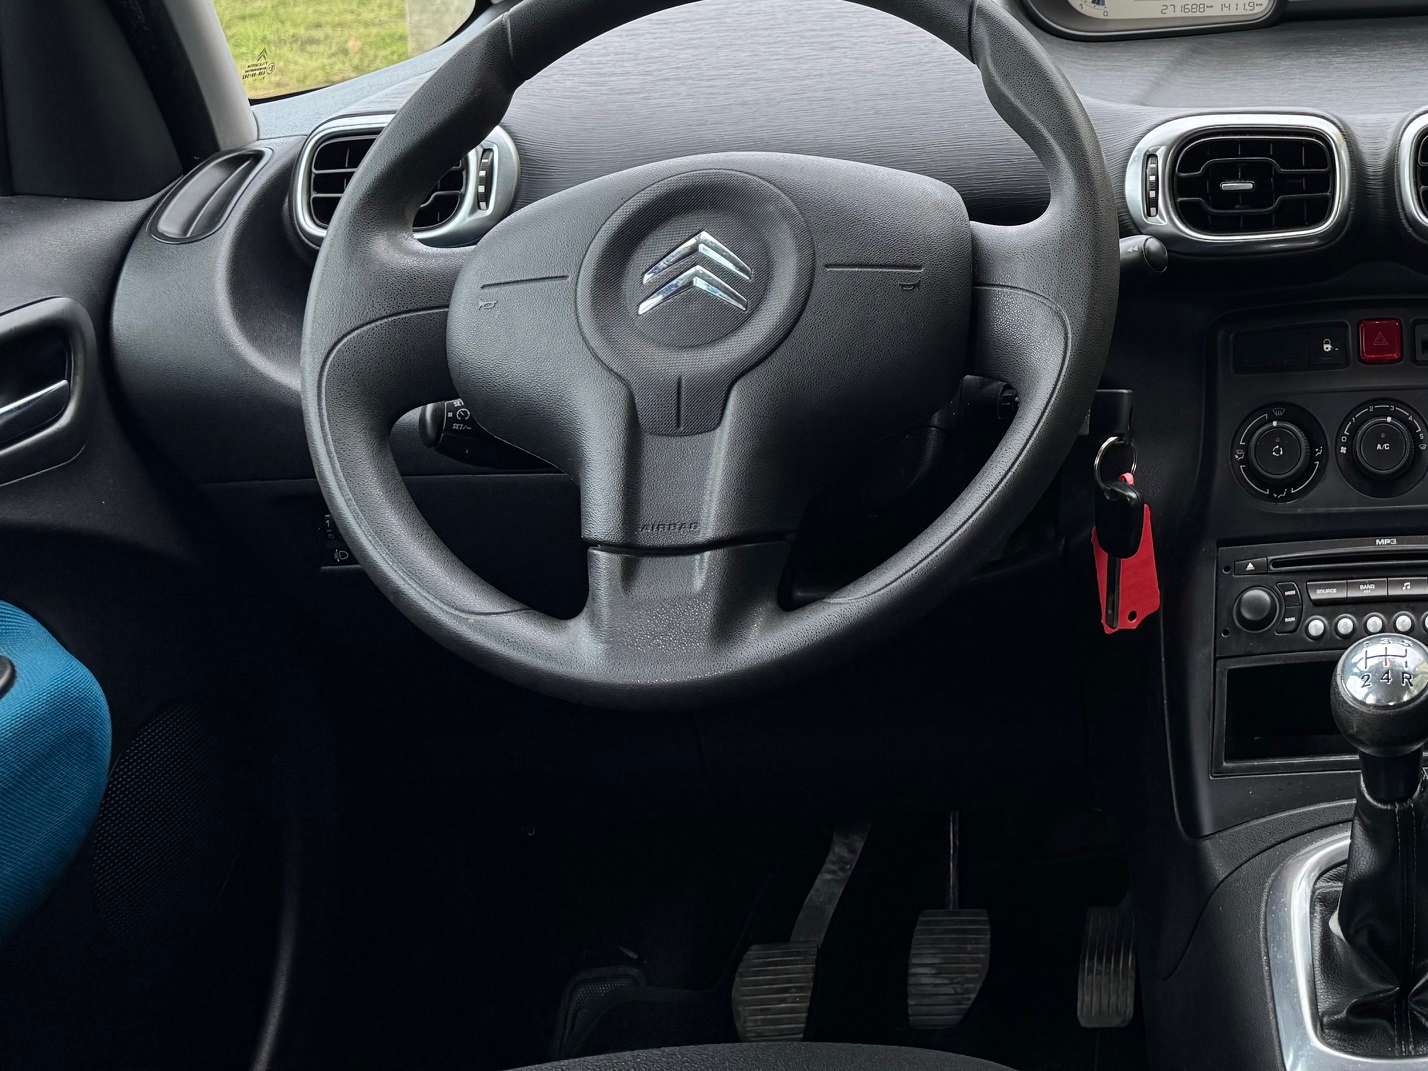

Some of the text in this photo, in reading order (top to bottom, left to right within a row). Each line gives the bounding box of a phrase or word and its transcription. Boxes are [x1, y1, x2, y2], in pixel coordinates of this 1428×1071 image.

[1103, 10, 1109, 18] 0
[1375, 538, 1397, 546] MP3
[1361, 670, 1413, 688] 2 4 R
